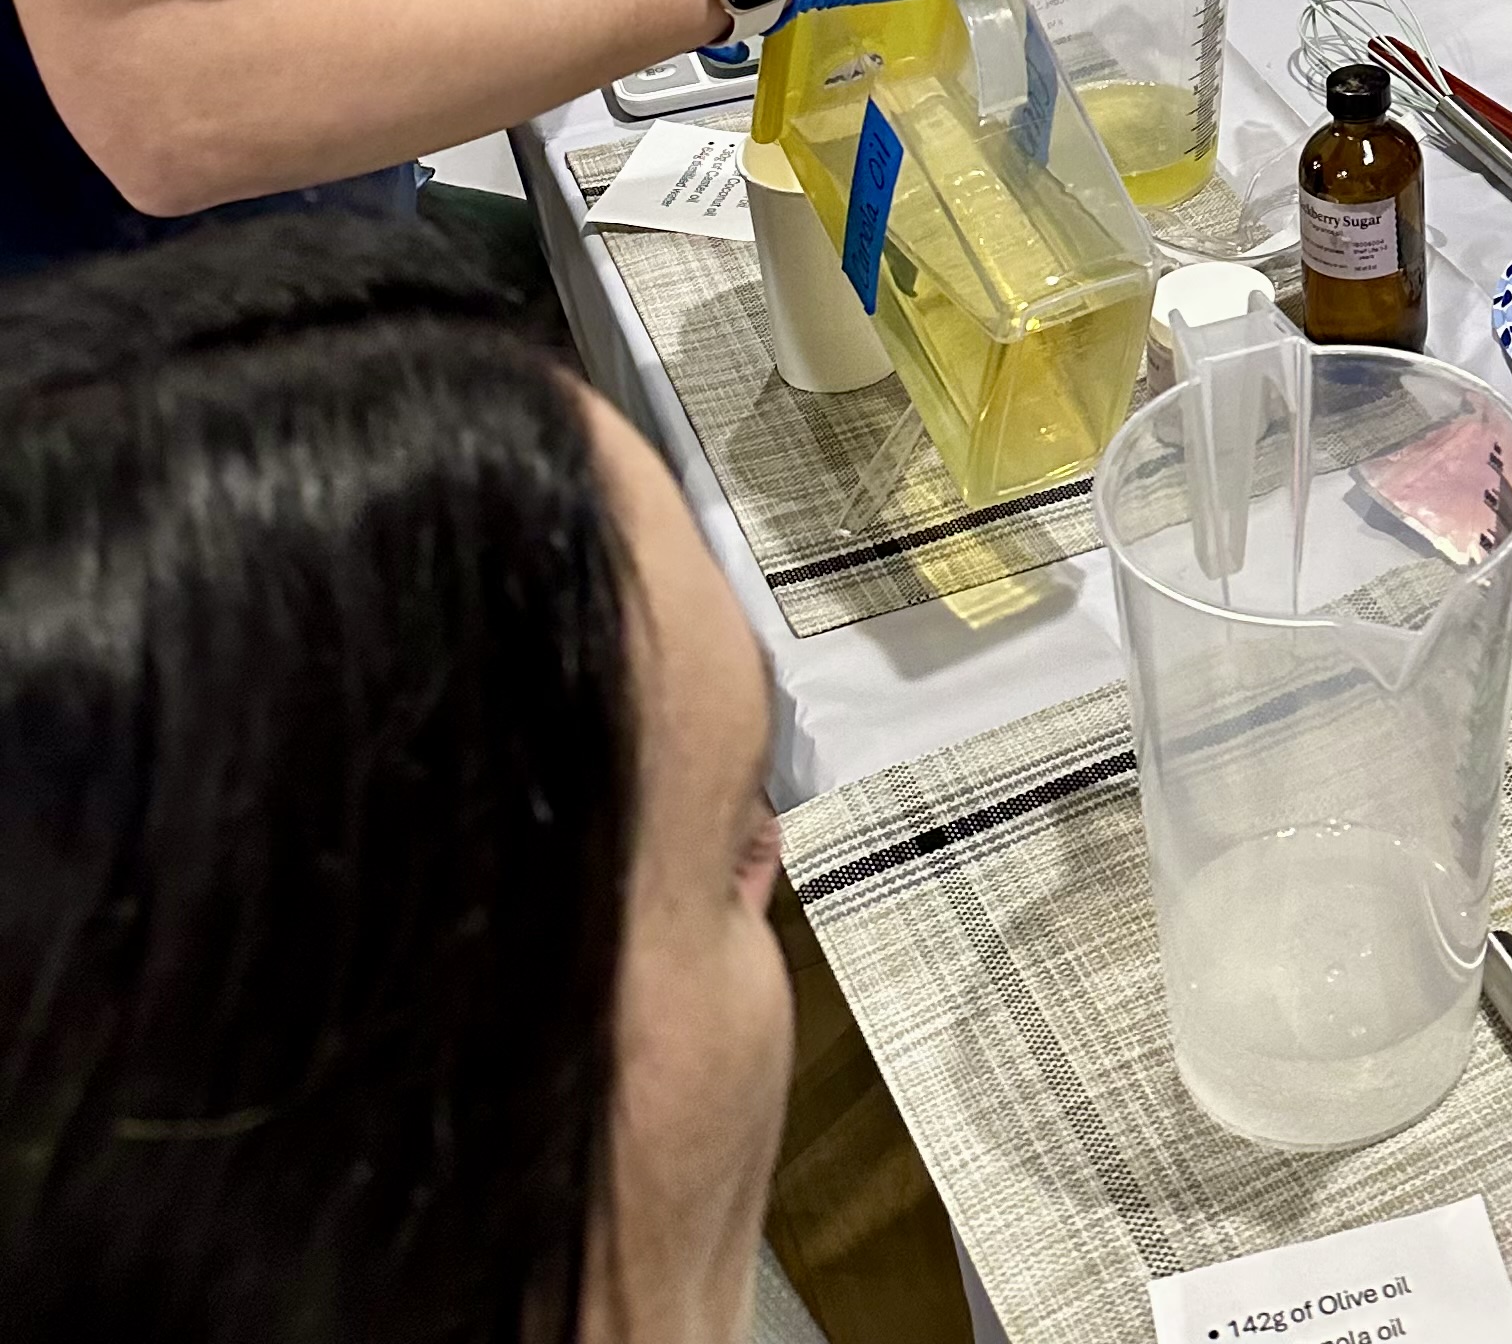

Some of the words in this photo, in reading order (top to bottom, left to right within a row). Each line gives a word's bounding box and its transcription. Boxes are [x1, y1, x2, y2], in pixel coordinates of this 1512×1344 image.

[710, 178, 740, 207] Coconut
[1343, 215, 1382, 230] Sugar
[1227, 1310, 1288, 1338] 142g
[1290, 1300, 1314, 1323] of
[1318, 1285, 1379, 1316] Olive
[1382, 1276, 1412, 1299] oil
[1378, 1317, 1407, 1340] oil
